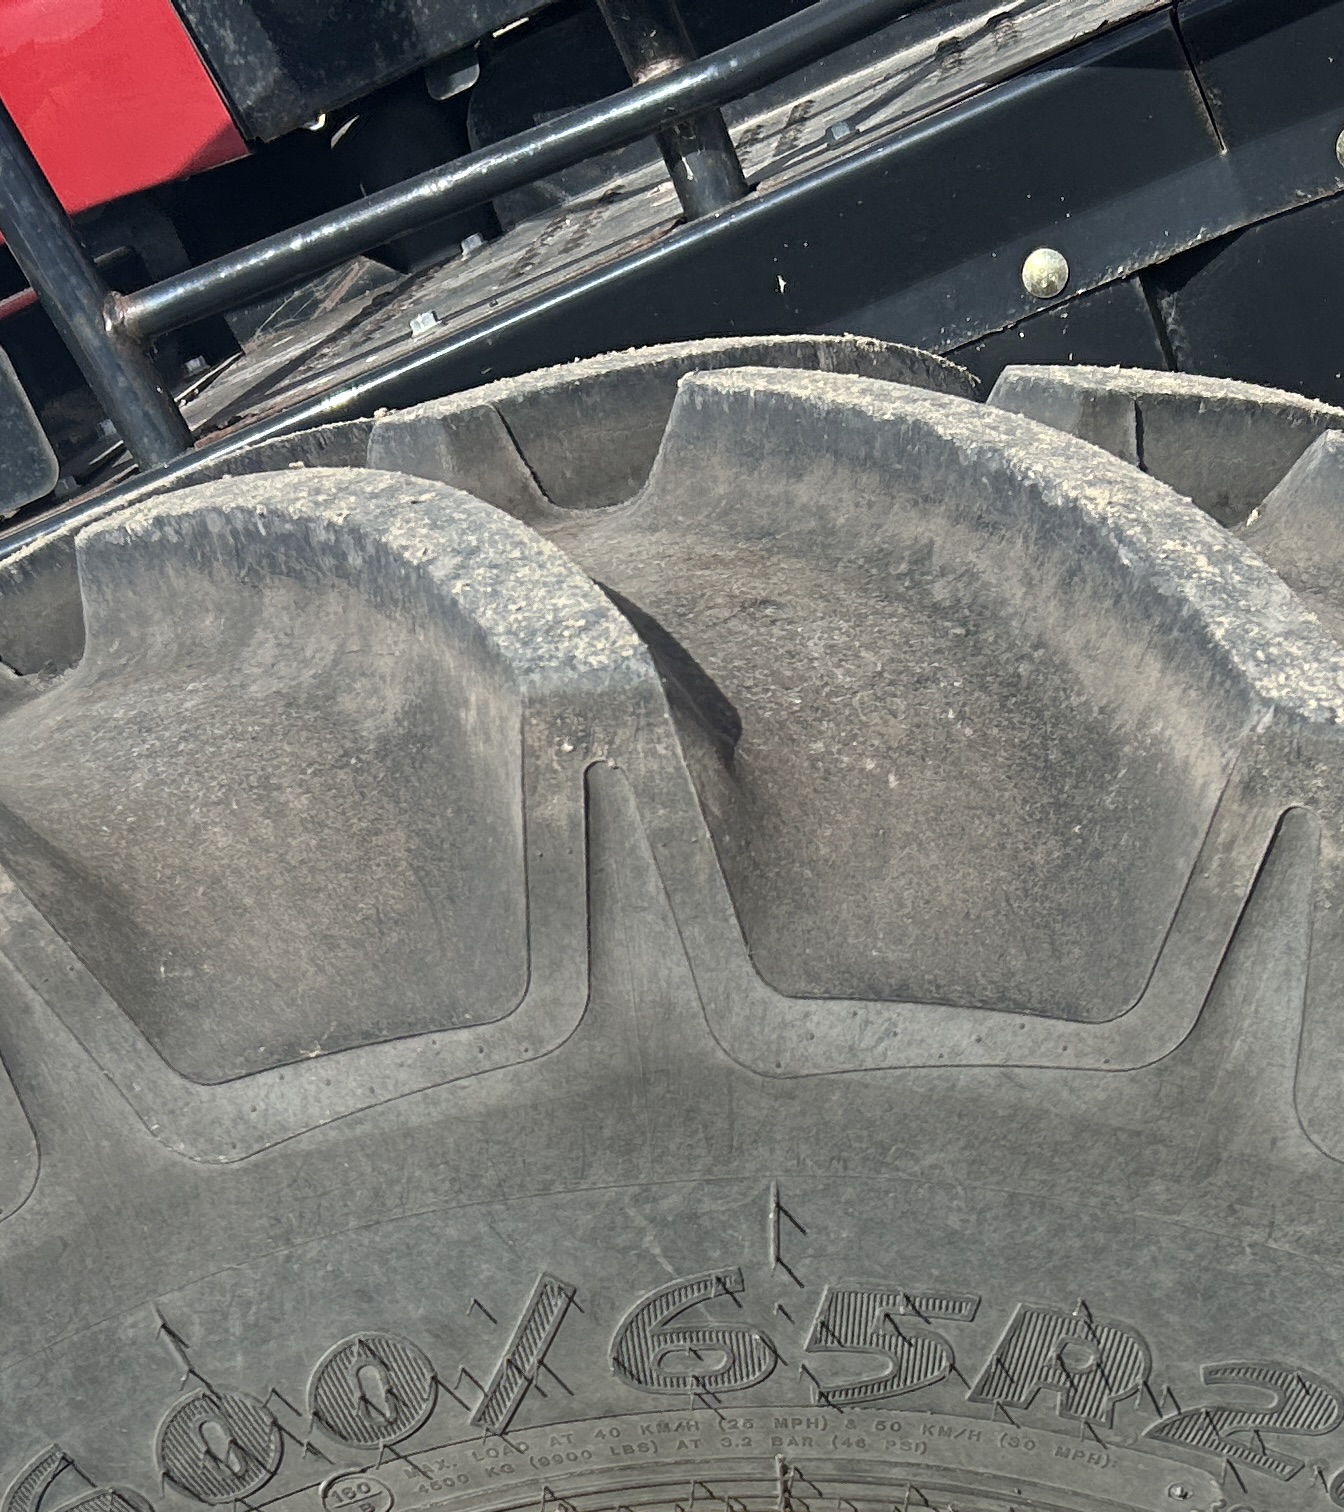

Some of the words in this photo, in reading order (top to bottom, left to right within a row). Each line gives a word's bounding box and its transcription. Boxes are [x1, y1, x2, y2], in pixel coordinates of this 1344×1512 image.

[471, 1440, 531, 1463] LOAD
[549, 1431, 577, 1449] AT
[594, 1425, 622, 1442] 40
[639, 1418, 702, 1438] KM/H
[716, 1417, 756, 1434] (25
[772, 1415, 830, 1434] MPH)
[920, 1421, 983, 1444] KM/H
[484, 1462, 516, 1478] KG
[610, 1439, 658, 1459] LBS)
[675, 1437, 700, 1451] AT
[720, 1435, 753, 1450] 3.2
[770, 1435, 814, 1450] BAR
